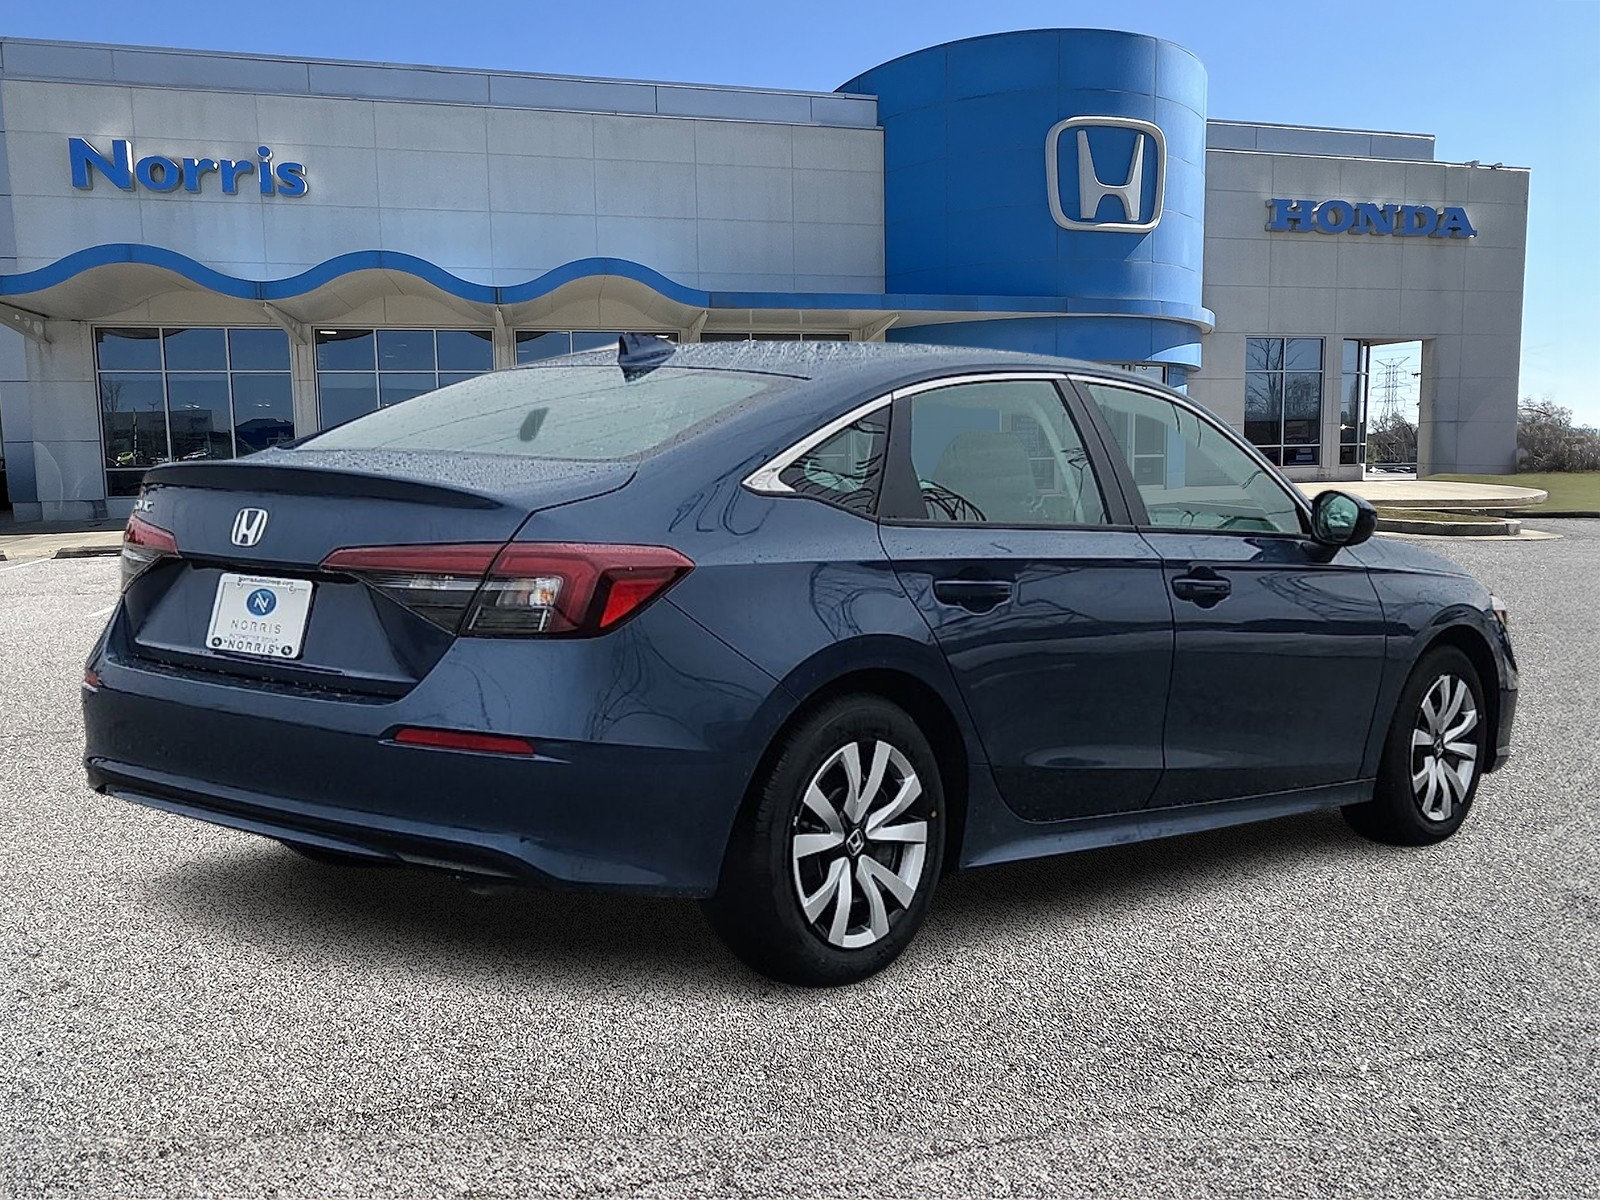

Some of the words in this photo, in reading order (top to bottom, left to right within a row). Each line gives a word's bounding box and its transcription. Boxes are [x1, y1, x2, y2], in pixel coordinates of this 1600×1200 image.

[68, 137, 309, 197] Norris
[1265, 198, 1477, 238] HONDA
[231, 619, 281, 635] NORRIS
[228, 639, 275, 654] NORRIS
